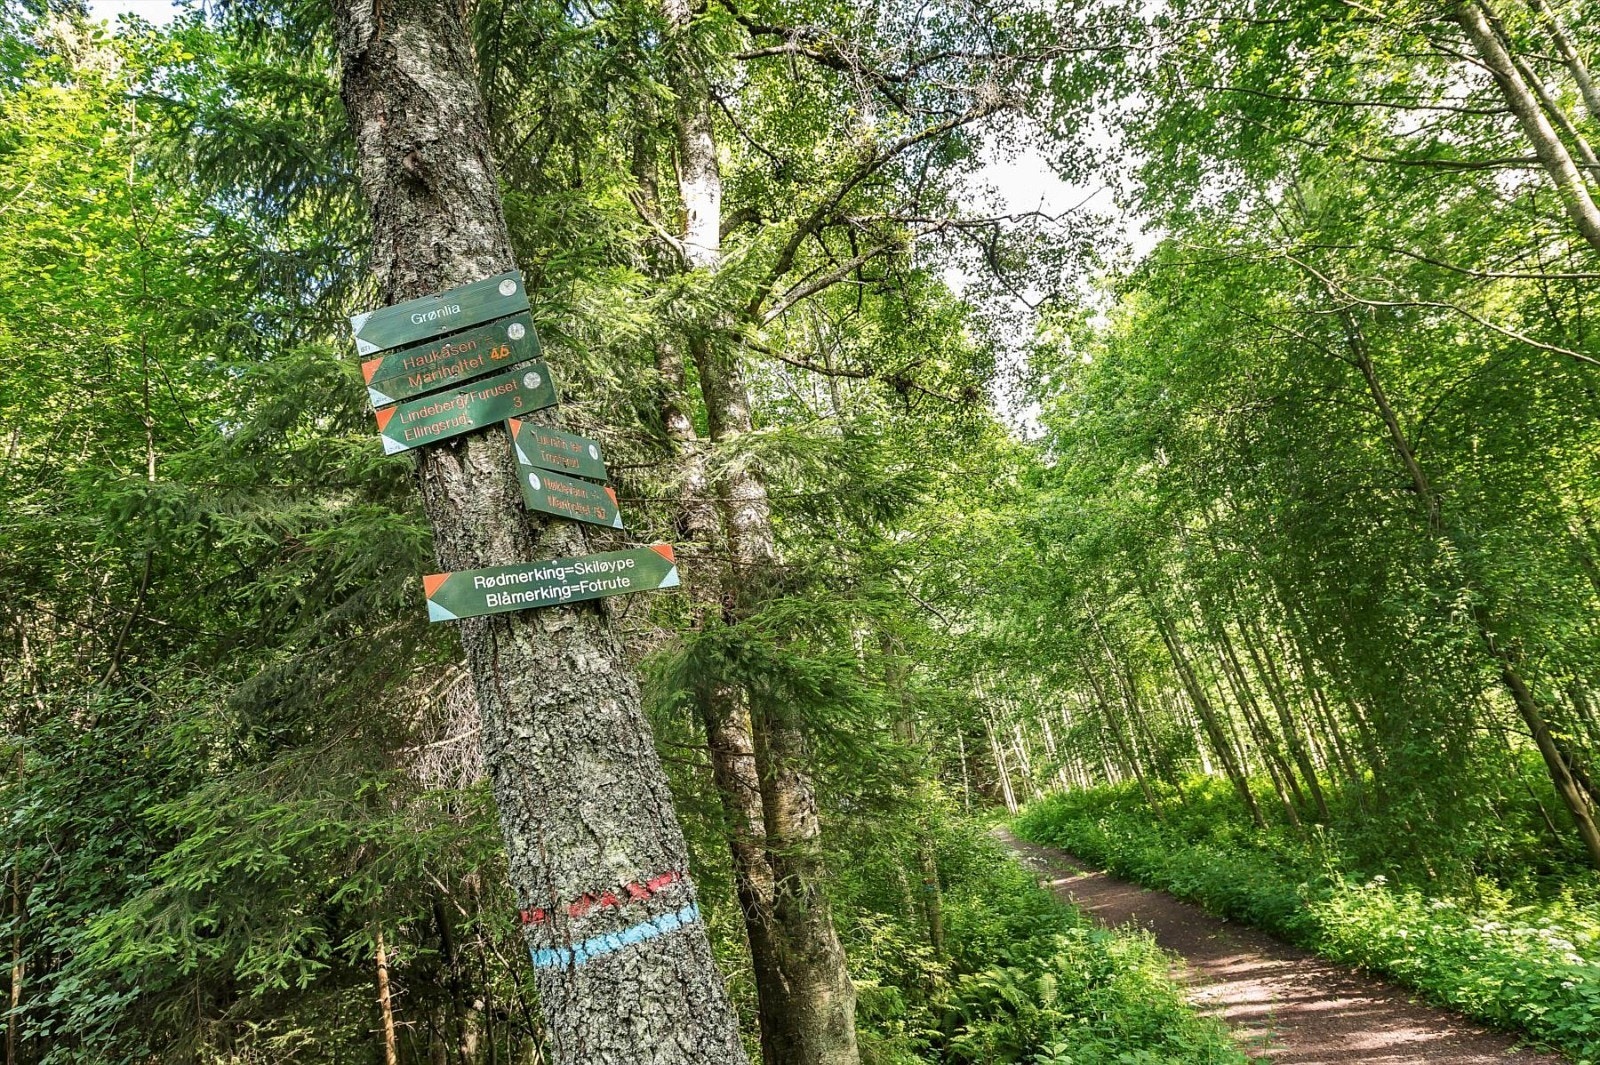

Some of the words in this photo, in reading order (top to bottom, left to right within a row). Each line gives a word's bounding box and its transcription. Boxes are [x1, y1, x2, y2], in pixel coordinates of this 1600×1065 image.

[410, 303, 461, 325] Grønlia
[403, 339, 477, 371] Haukåsen
[408, 353, 485, 388] Mariholtet
[404, 412, 467, 441] Ellingsrud
[513, 396, 523, 408] 3
[474, 557, 635, 590] Rødmerking=Skiløype
[485, 576, 631, 608] Blåmerking=Fotrute
